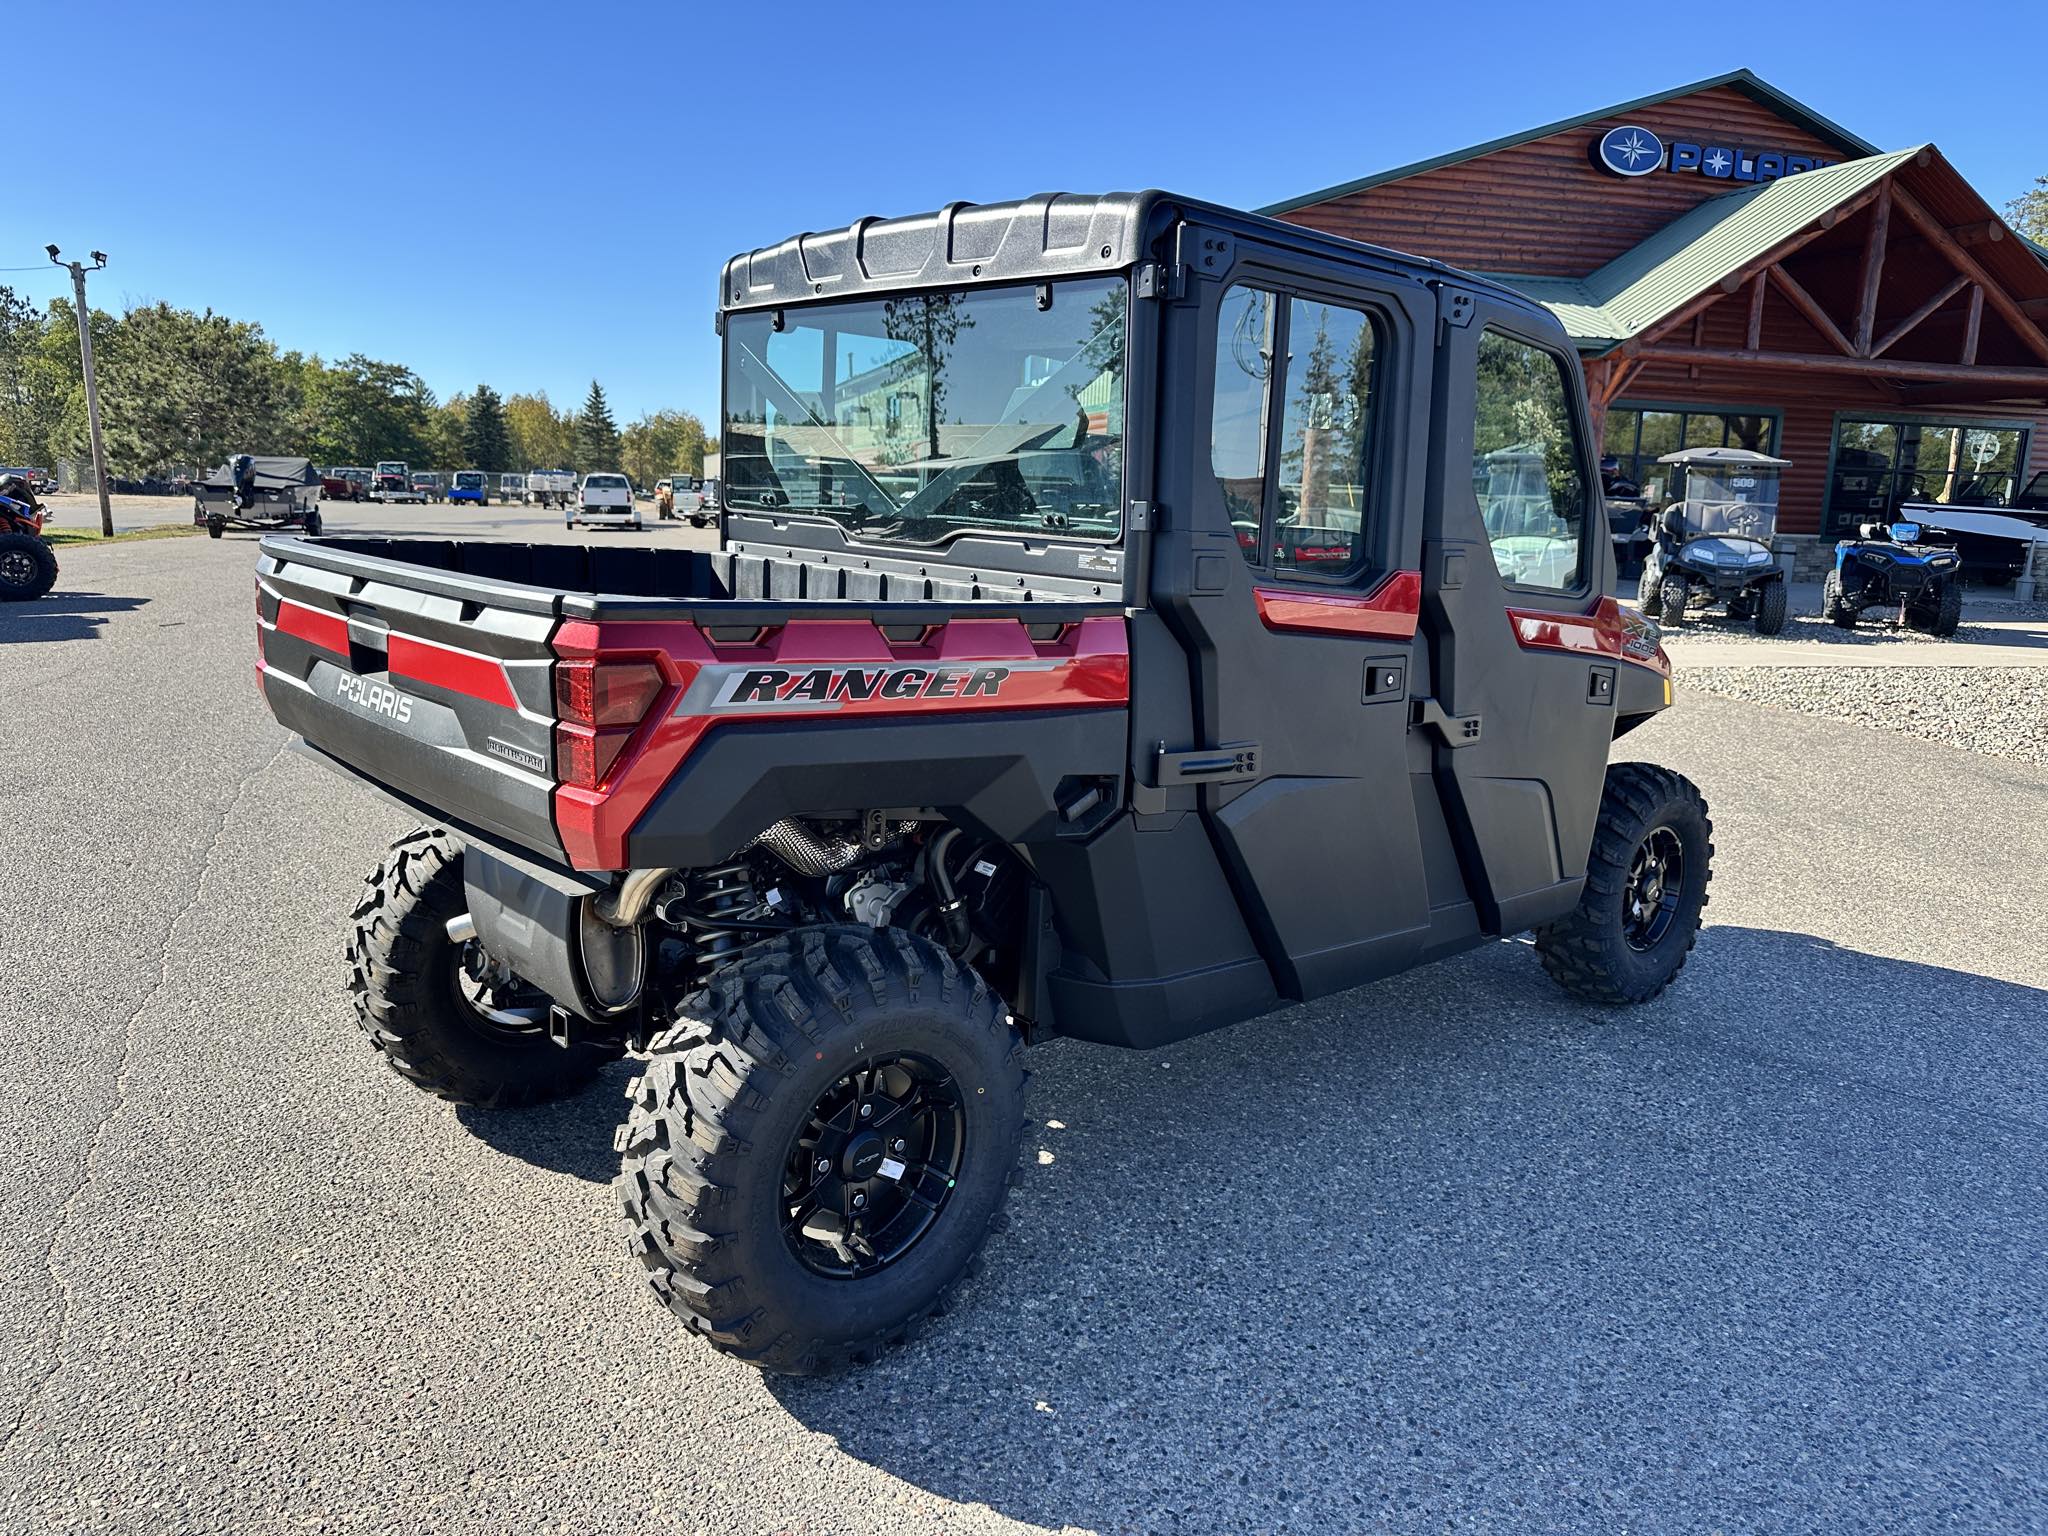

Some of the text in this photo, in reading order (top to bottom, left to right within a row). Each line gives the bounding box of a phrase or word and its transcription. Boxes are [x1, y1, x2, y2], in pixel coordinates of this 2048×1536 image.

[1622, 618, 1659, 641] XP
[1630, 640, 1656, 655] 1000
[337, 673, 414, 723] POLARIS
[727, 667, 1010, 703] RANGER
